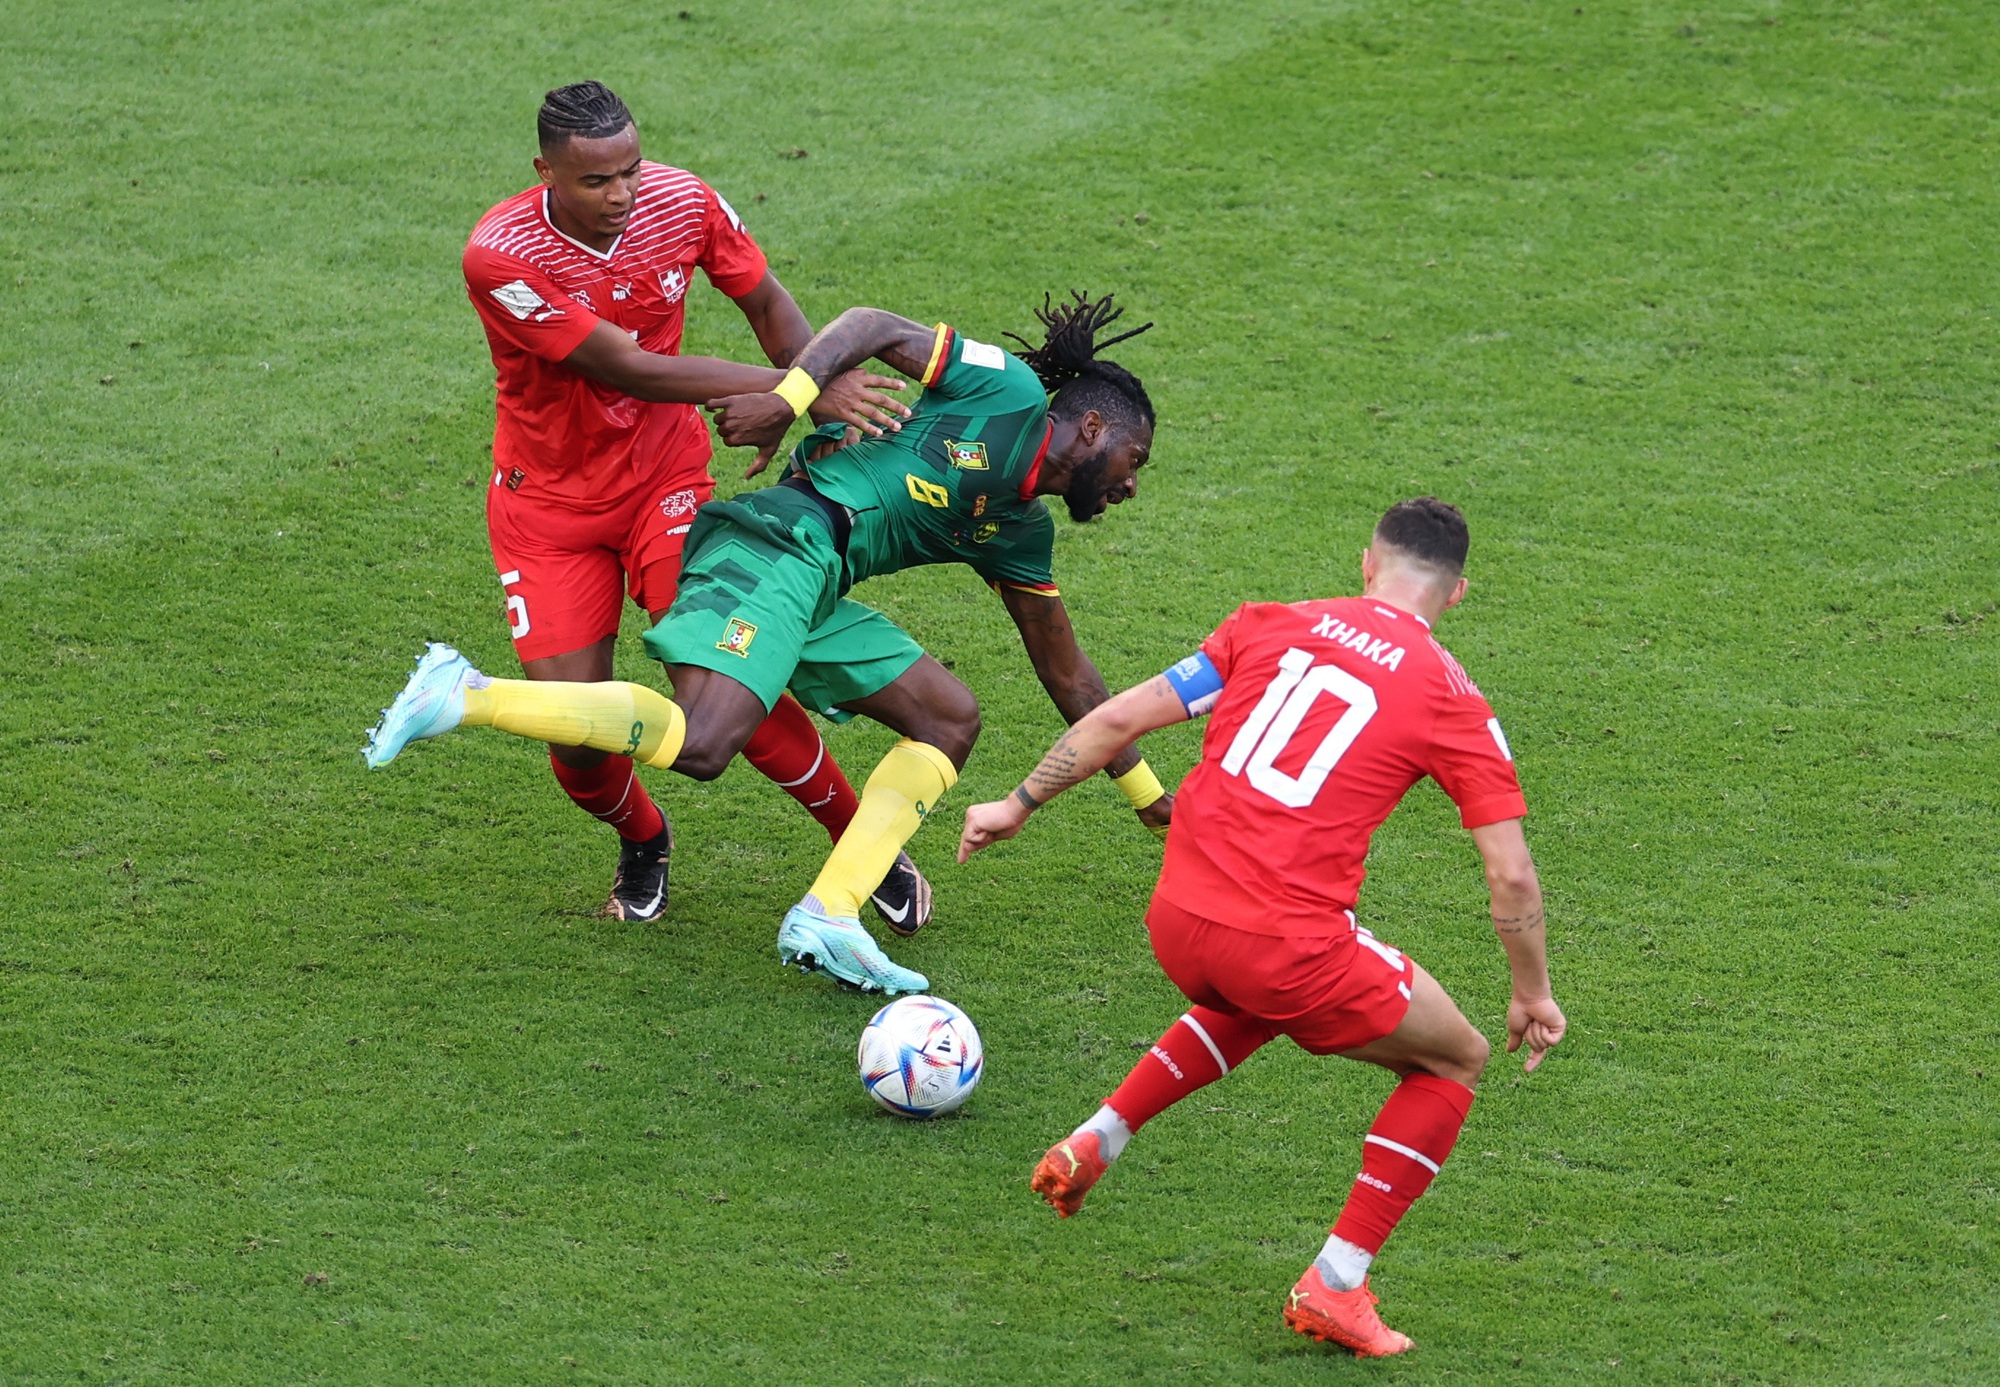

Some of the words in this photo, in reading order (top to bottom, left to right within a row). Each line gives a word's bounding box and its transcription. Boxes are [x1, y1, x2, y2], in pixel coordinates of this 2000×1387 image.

[906, 473, 948, 508] 8
[666, 523, 692, 536] PUM
[500, 569, 531, 640] 5
[1310, 613, 1406, 672] XHAKA
[1220, 647, 1379, 808] 10
